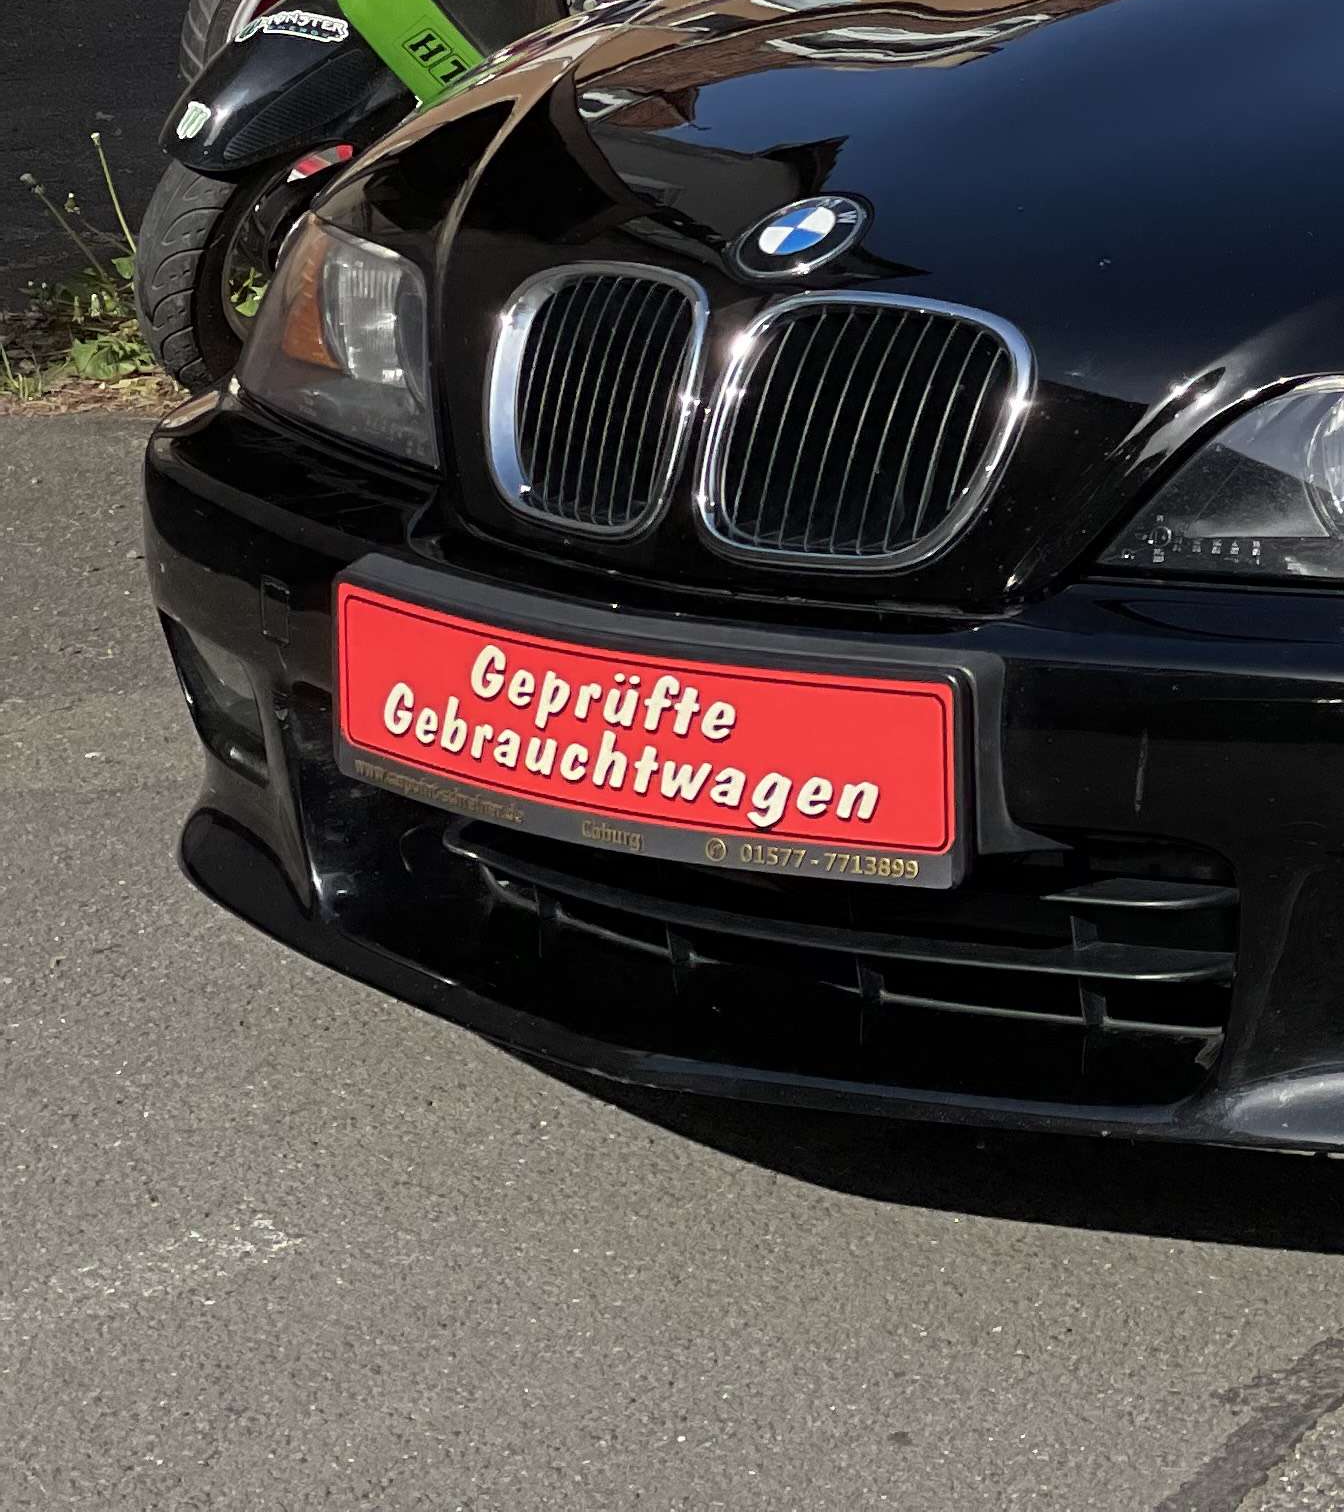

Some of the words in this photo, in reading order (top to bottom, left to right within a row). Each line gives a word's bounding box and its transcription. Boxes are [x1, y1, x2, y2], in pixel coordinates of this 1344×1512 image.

[470, 644, 737, 741] Geprüfte
[383, 682, 880, 828] Gebrauchtwagen
[581, 820, 643, 852] Coburg
[740, 843, 807, 869] 01577
[823, 852, 920, 880] 7713899
